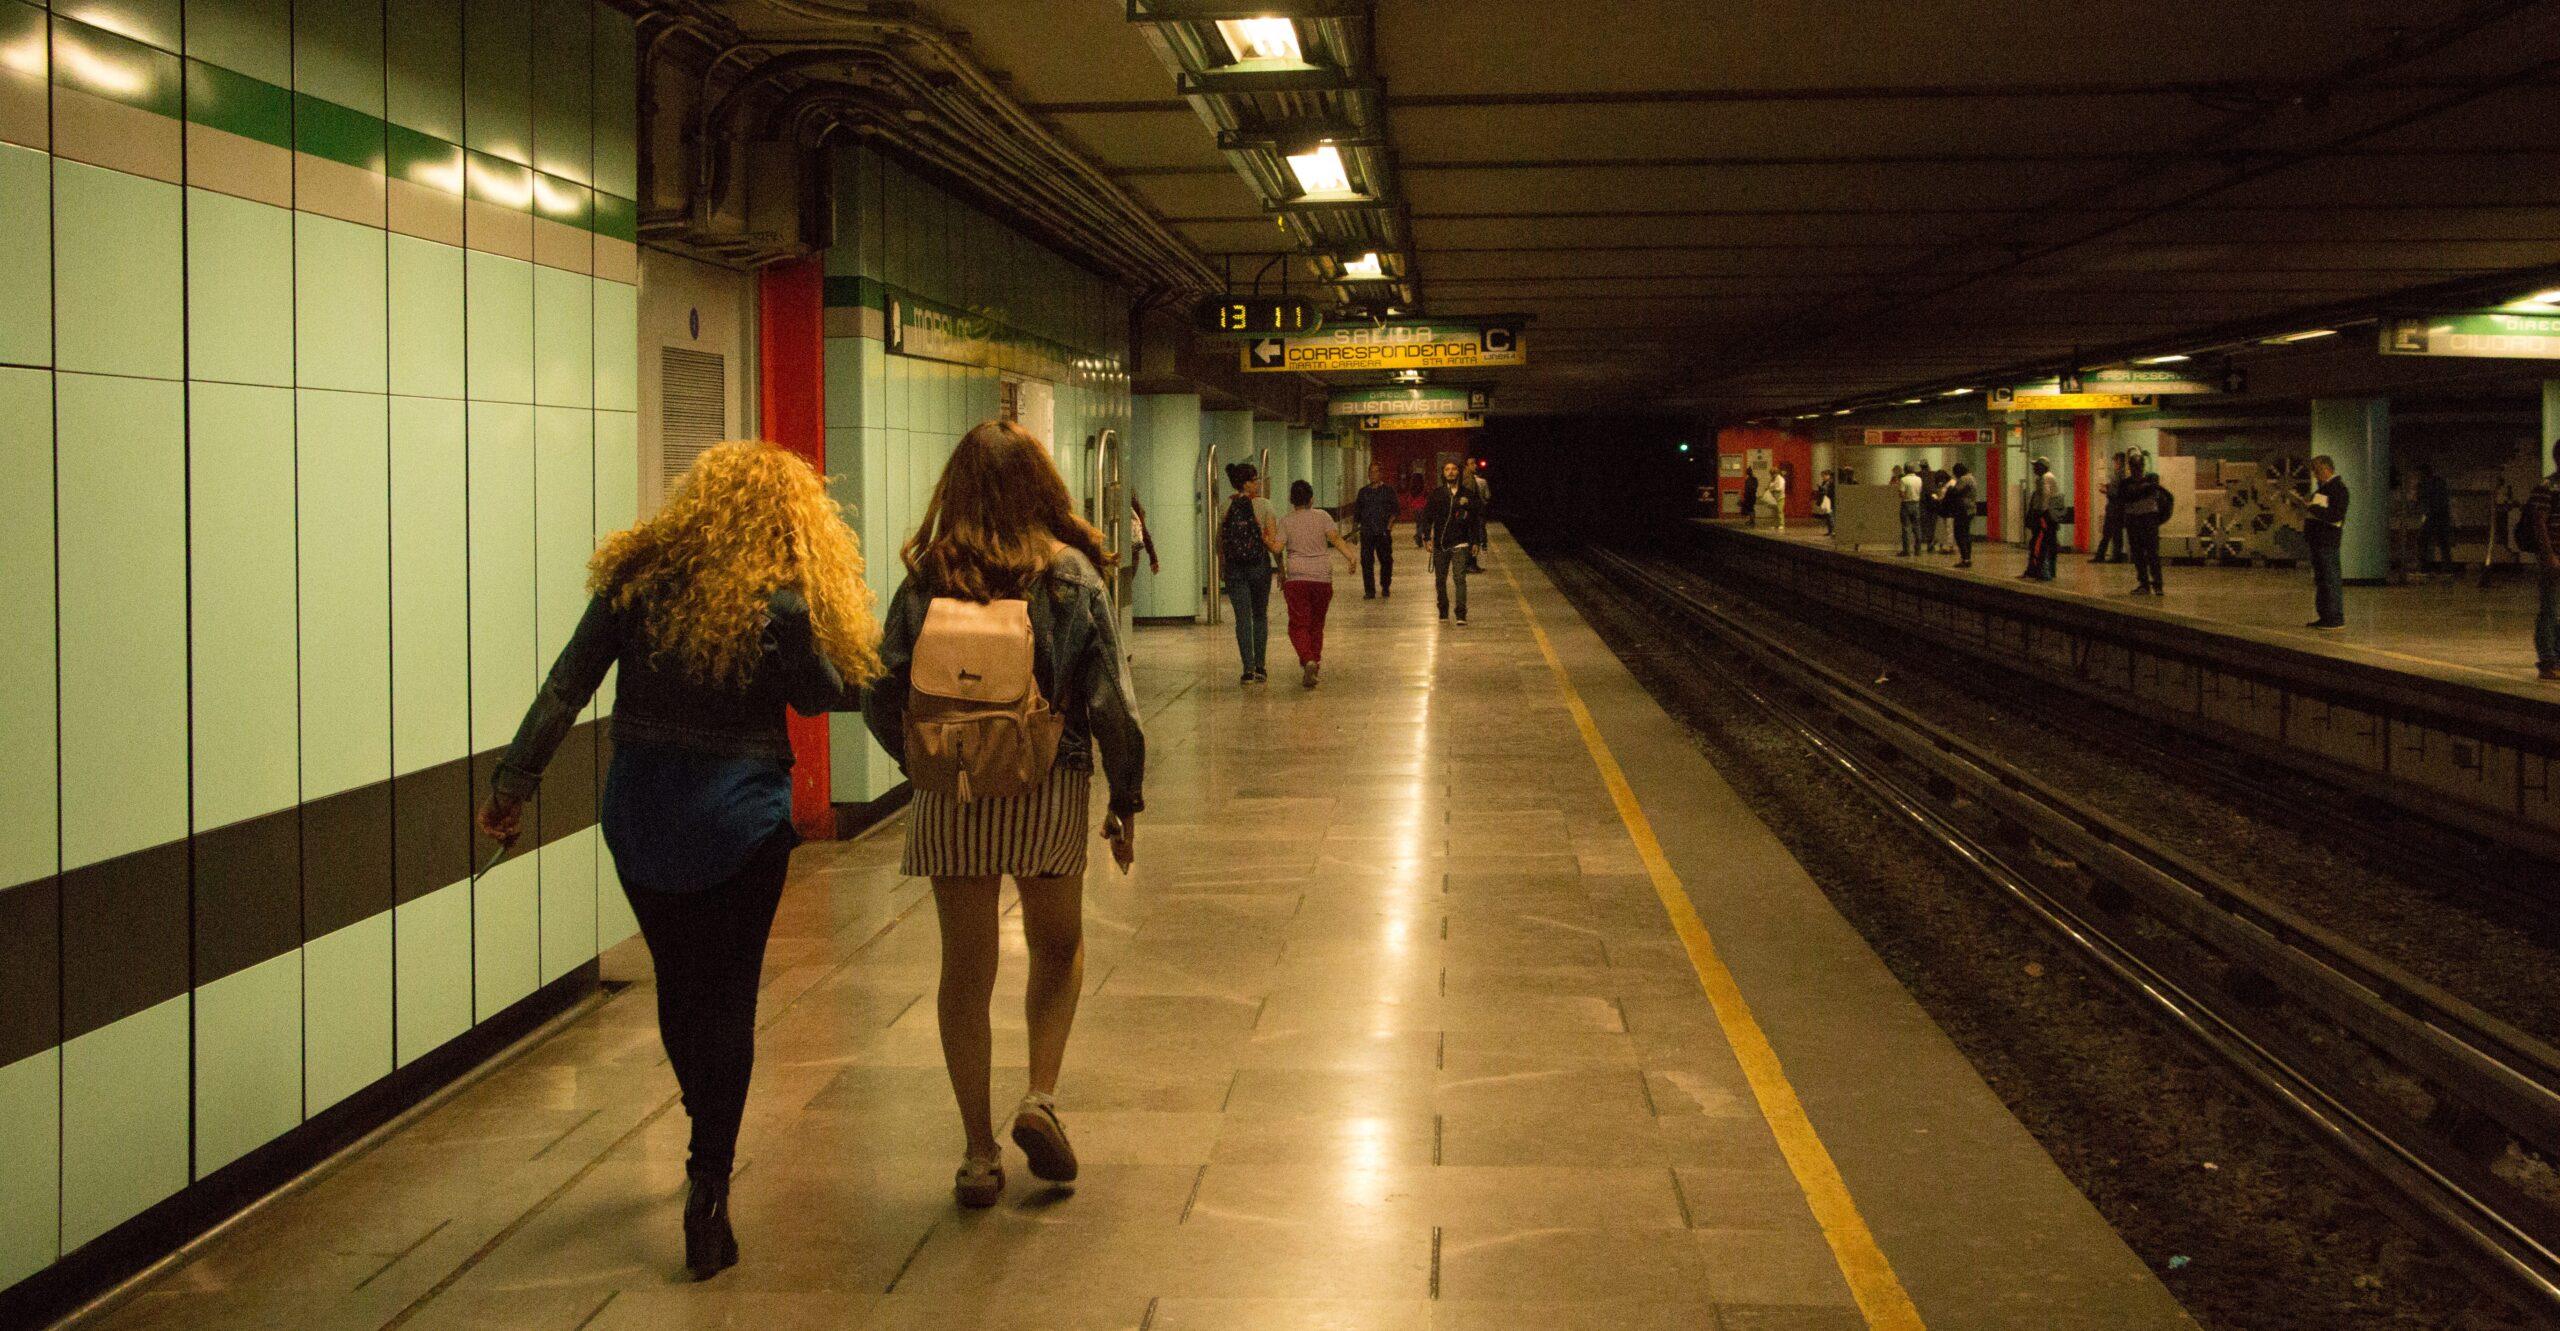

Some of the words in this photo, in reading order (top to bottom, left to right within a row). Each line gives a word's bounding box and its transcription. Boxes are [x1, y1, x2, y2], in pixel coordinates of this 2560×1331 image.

[1220, 304, 1247, 330] 13
[1274, 305, 1303, 329] 11
[1334, 327, 1432, 344] SALIDA
[1486, 328, 1511, 352] C
[2450, 335, 2545, 351] CIUDAD
[1288, 343, 1477, 361] CORRESPONDENCIA
[1332, 359, 1382, 369] CARRERA
[1422, 357, 1442, 366] STA
[1448, 356, 1478, 365] ANITA
[1342, 399, 1453, 413] BUENAVISTA
